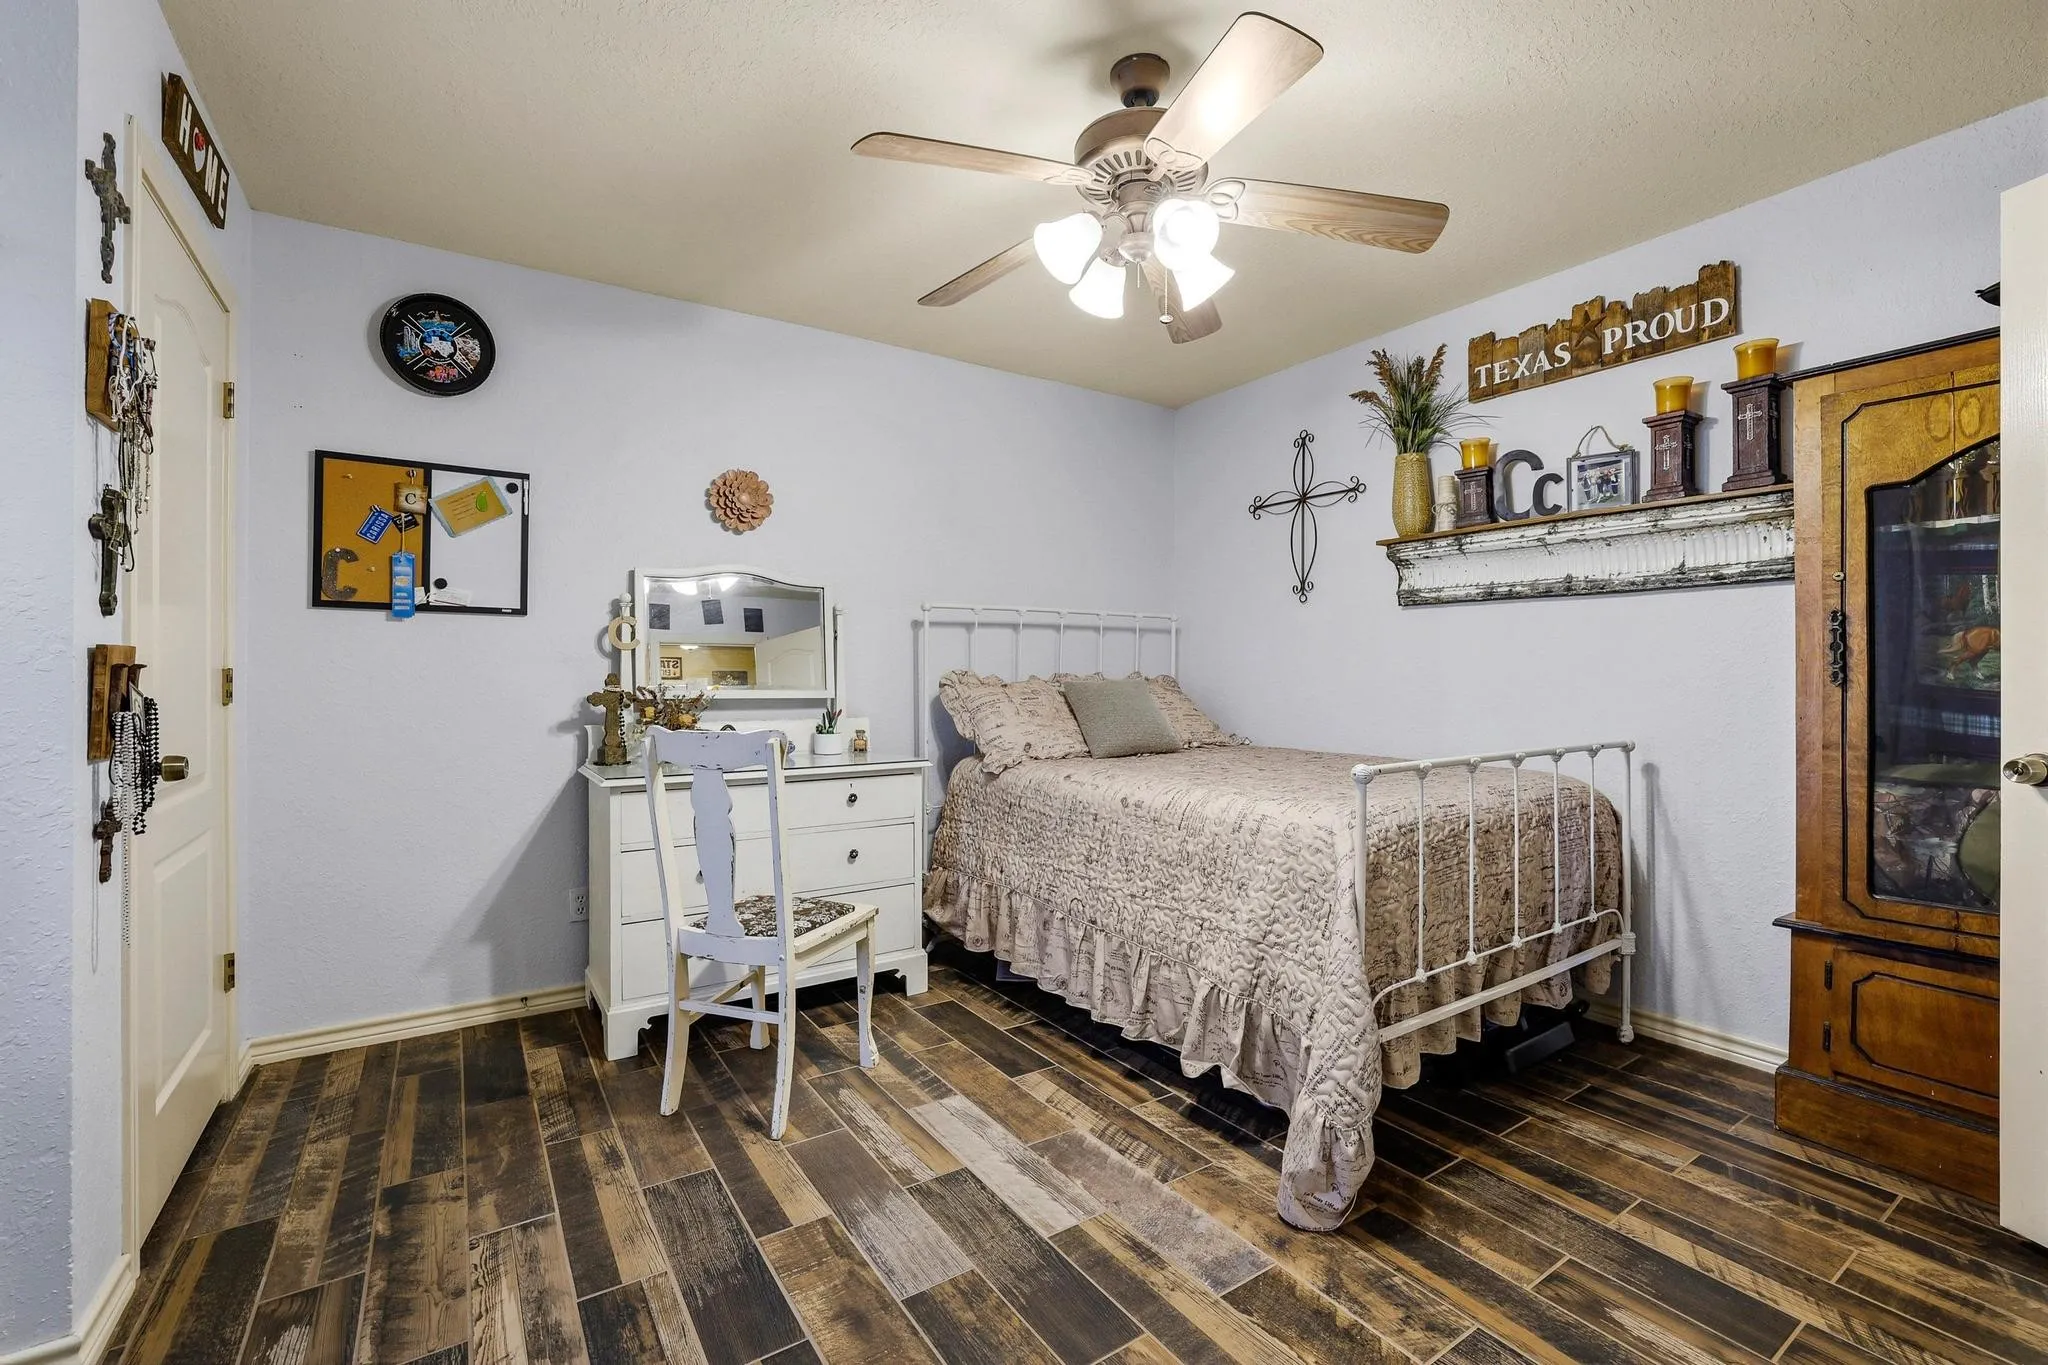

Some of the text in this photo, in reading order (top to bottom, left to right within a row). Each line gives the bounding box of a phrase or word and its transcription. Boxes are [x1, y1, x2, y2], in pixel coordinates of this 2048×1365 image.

[179, 93, 228, 219] HOME
[1474, 297, 1730, 389] TEXAS PROUD
[366, 513, 389, 539] CARISSA
[405, 493, 418, 505] C
